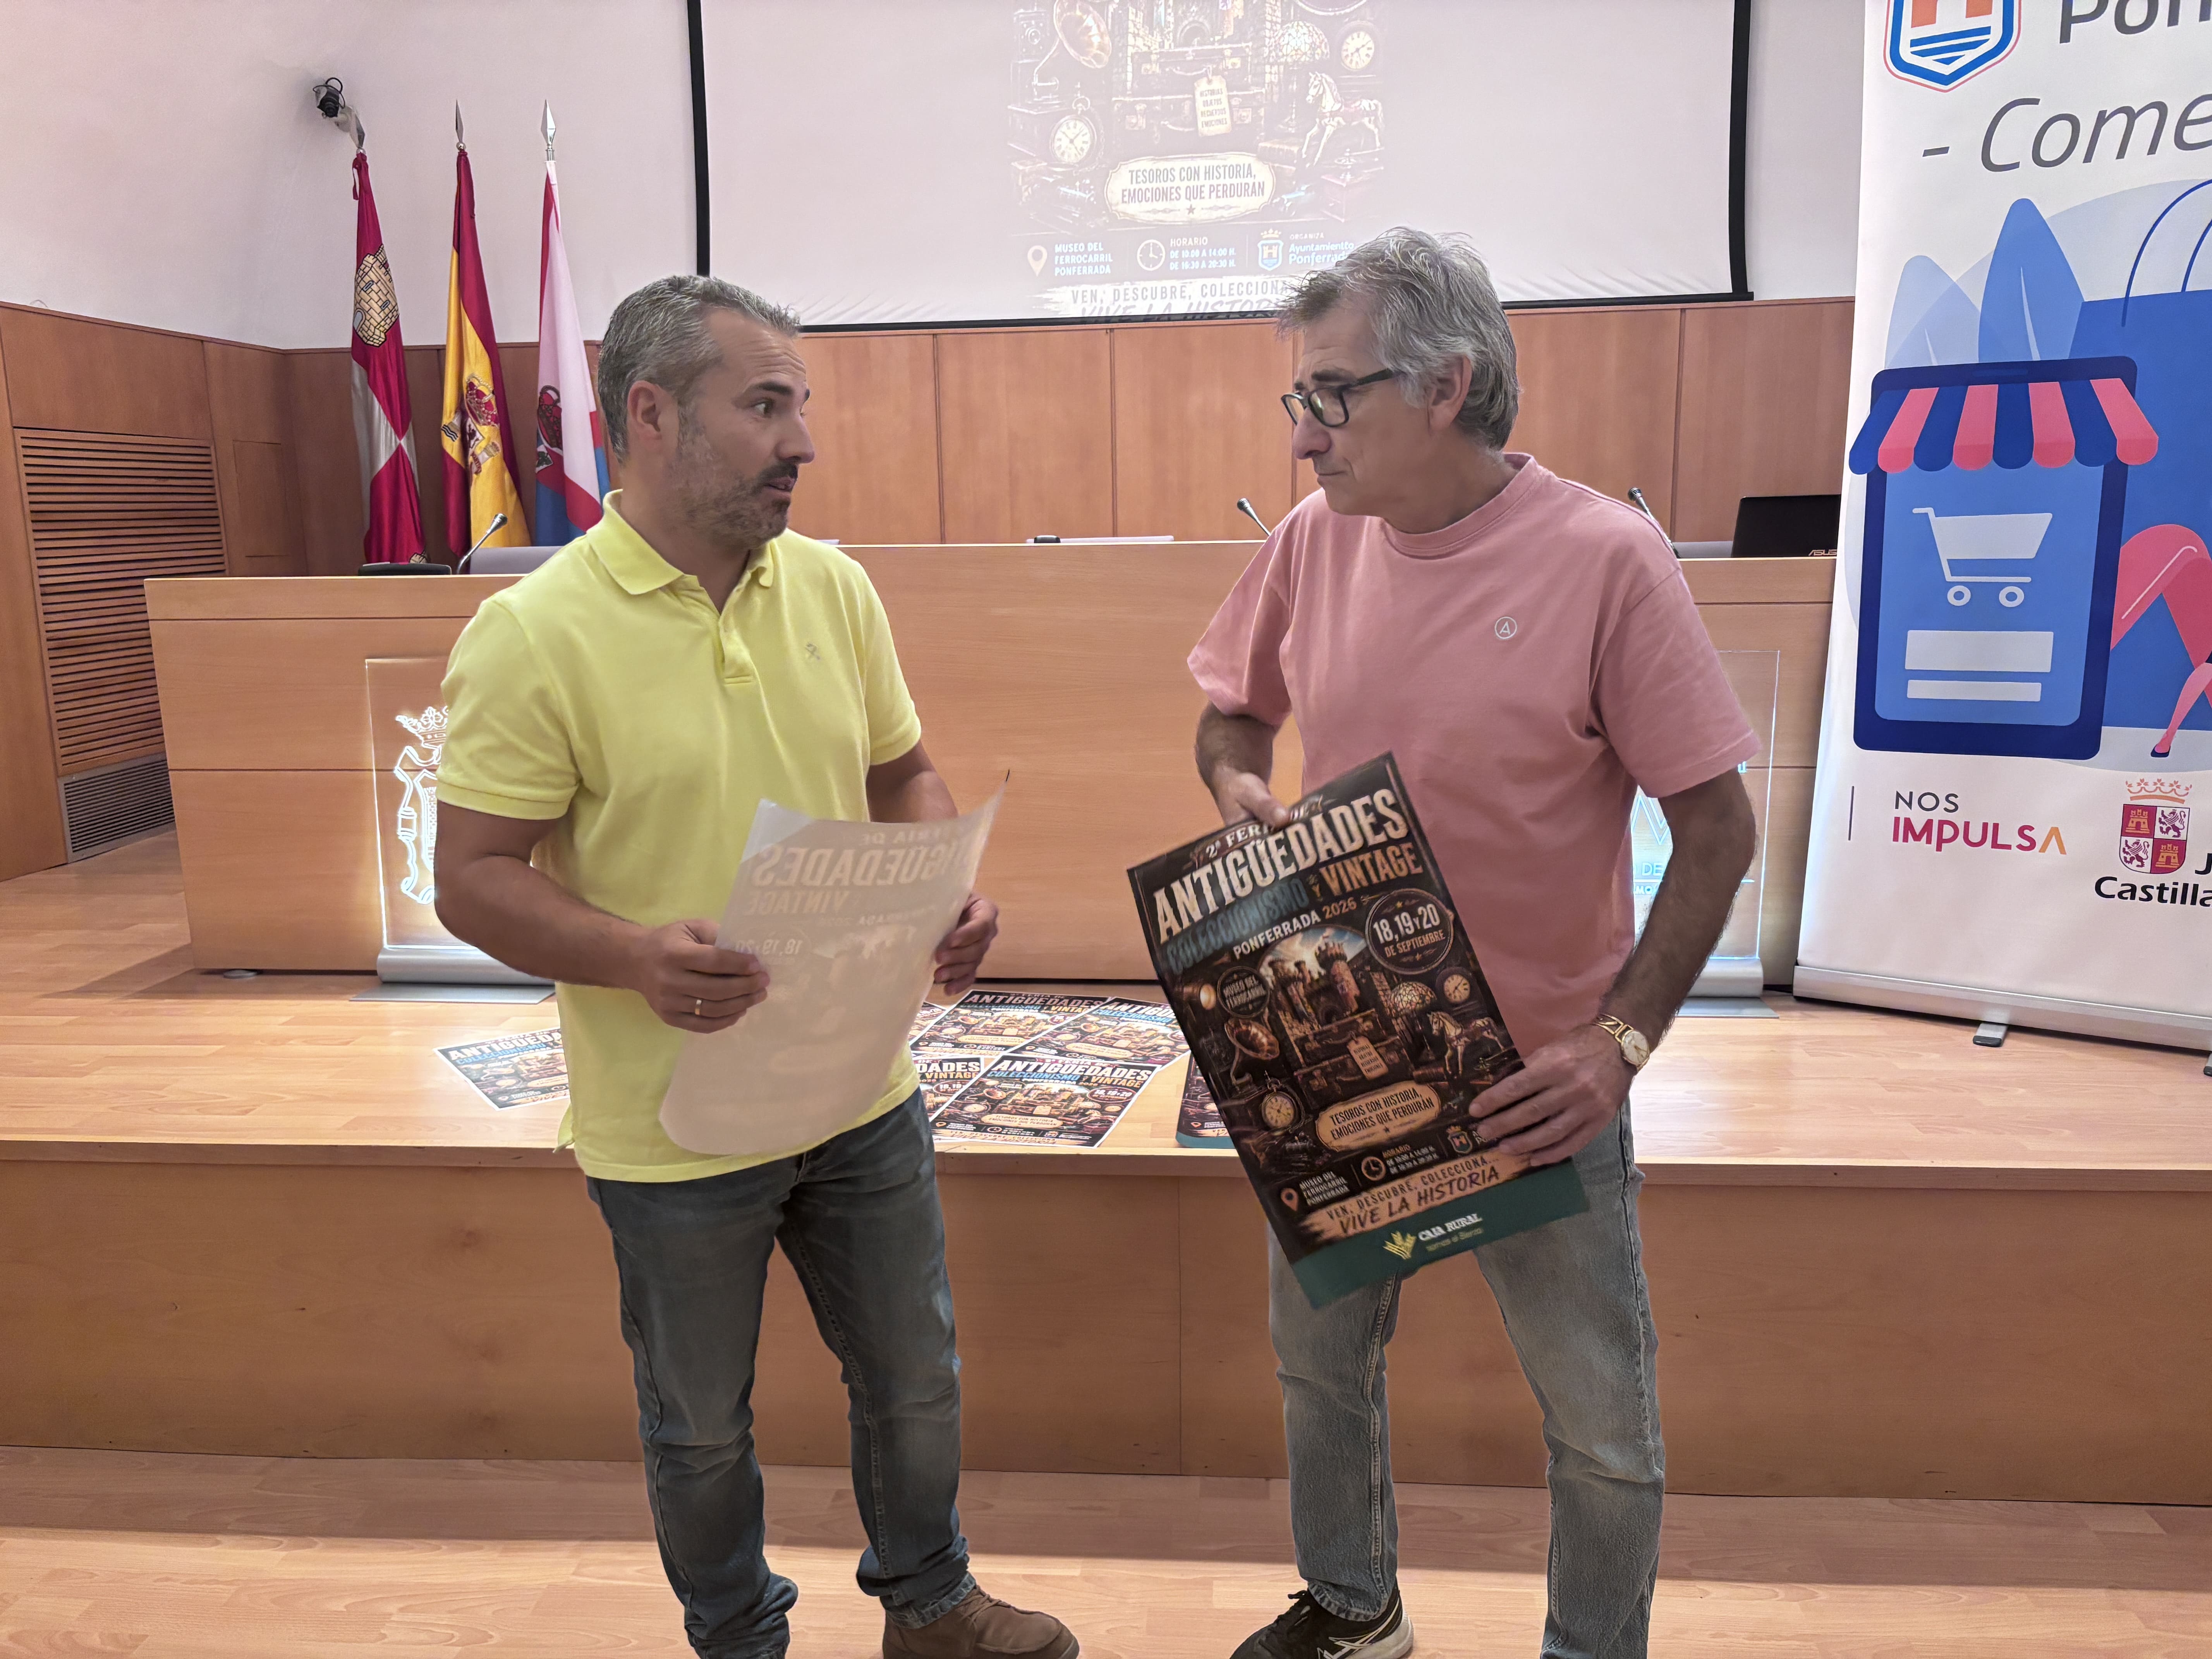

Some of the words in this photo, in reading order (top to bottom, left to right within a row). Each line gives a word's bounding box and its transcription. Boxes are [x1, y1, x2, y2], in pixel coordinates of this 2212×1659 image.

[1981, 94, 2212, 172] Come
[1128, 167, 1176, 185] TESOROS
[1179, 166, 1200, 182] CON
[1204, 163, 1256, 180] HISTORIA,
[1121, 186, 1182, 204] EMOCIONES
[1185, 184, 1205, 202] QUE
[1054, 243, 1085, 253] MUSEO
[1087, 242, 1104, 252] DEL
[1170, 237, 1208, 247] HORARIO
[1054, 253, 1113, 265] FERROCARRIL
[1170, 250, 1179, 259] DE
[1201, 249, 1207, 257] A
[1170, 261, 1179, 270] DE
[1201, 260, 1206, 268] A
[1054, 264, 1111, 276] PONFERRADA
[1894, 791, 1959, 813] NOS
[1892, 816, 2067, 855] IMPULSA
[1153, 789, 1408, 944] ANTIGÜEDADES
[1319, 842, 1423, 896] VINTAGE
[2095, 876, 2212, 907] Castilla
[1233, 910, 1321, 960] PONFERRADA
[1384, 945, 1396, 958] DE
[1396, 930, 1446, 953] SEPTIEMBRE
[987, 1070, 1080, 1081] COLECCIONISMO
[1091, 1076, 1144, 1088] VINTAGE
[1329, 1105, 1366, 1125] TESOROS
[1366, 1099, 1383, 1113] CON
[1330, 1116, 1377, 1140] EMOCIONES
[1376, 1110, 1393, 1125] QUE
[1340, 1206, 1381, 1234] VIVE
[1388, 1196, 1411, 1218] LA
[1417, 1166, 1499, 1207] HISTORIA
[1444, 1213, 1483, 1232] RURAL
